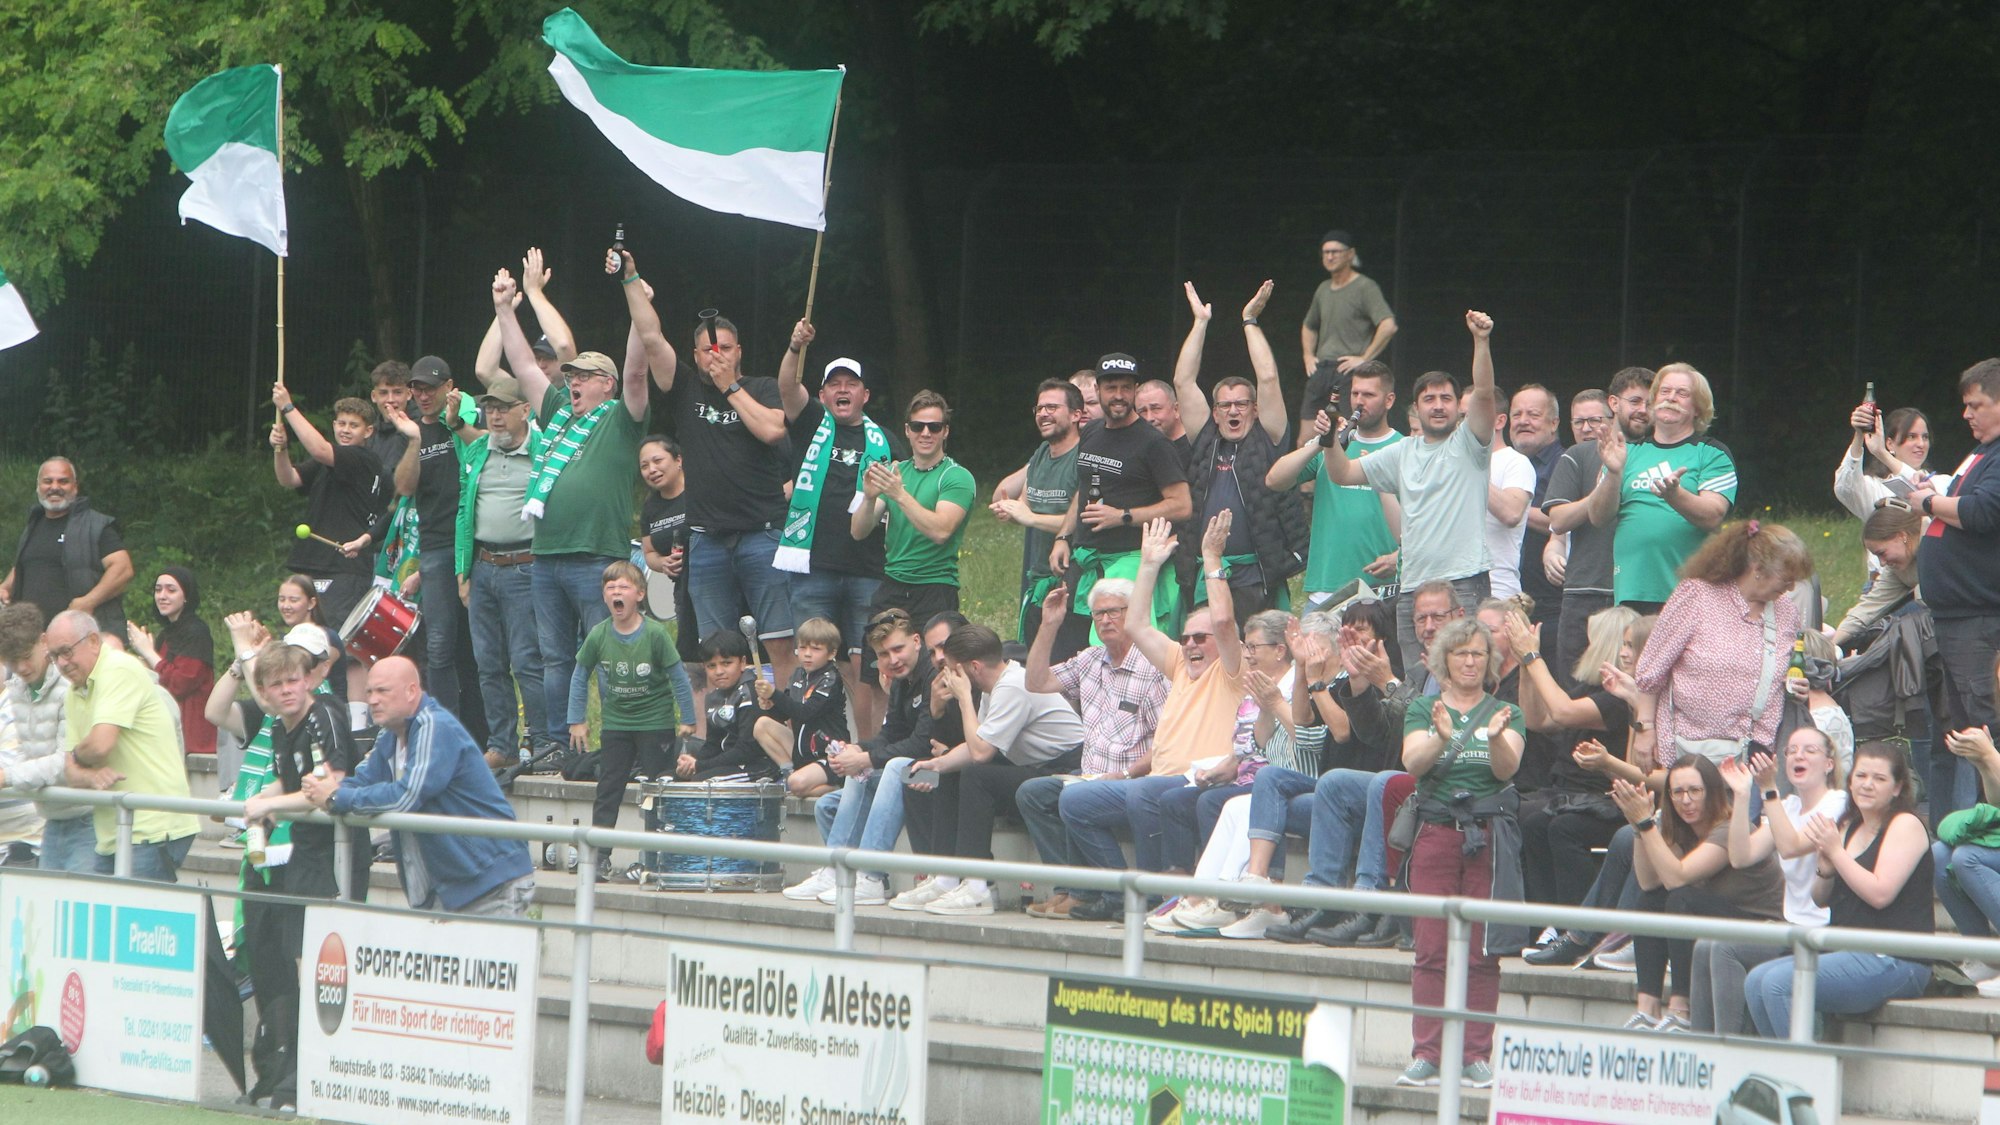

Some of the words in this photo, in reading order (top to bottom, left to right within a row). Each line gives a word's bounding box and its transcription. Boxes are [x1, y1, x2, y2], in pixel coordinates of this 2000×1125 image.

[1101, 358, 1136, 371] OAKLEY
[129, 922, 177, 957] PraeVita
[318, 962, 346, 984] SPORT
[354, 945, 460, 986] SPORT-CENTER
[463, 957, 518, 992] LINDEN
[319, 985, 342, 1005] 2000
[677, 959, 798, 1019] Mineralöle
[820, 973, 912, 1032] Aletsee
[1053, 981, 1168, 1028] Jugendförderung
[1170, 997, 1196, 1026] des
[1199, 1000, 1230, 1031] 1.FC
[1233, 1004, 1273, 1039] Spich
[352, 1000, 369, 1021] Für
[371, 1002, 397, 1025] Ihren
[400, 1005, 427, 1032] Sport
[430, 1009, 447, 1031] der
[450, 1012, 490, 1042] richtige
[493, 1018, 514, 1041] Ort!
[723, 1024, 757, 1047] Qualität
[766, 1029, 818, 1058] Zuverlässig
[827, 1036, 860, 1058] Ehrlich
[329, 1055, 376, 1078] Hauptstraße
[379, 1062, 393, 1079] 123
[400, 1065, 426, 1084] 53842
[428, 1068, 491, 1096] Troisdorf-Spich
[1501, 1036, 1593, 1078] Fahrschule
[1599, 1043, 1655, 1084] Walter
[1659, 1050, 1715, 1091] Müller
[310, 1080, 324, 1098] Tel.
[396, 1095, 510, 1124] www.sport-center-linden.de
[673, 1080, 726, 1118] Heizöle
[740, 1088, 786, 1125] Diesel
[1498, 1079, 1517, 1099] Hier
[1519, 1080, 1542, 1102] läuft
[1543, 1085, 1565, 1104] alles
[1567, 1088, 1589, 1108] rund
[1592, 1093, 1608, 1109] um
[1611, 1090, 1645, 1112] deinen
[1648, 1093, 1712, 1118] Führerschein
